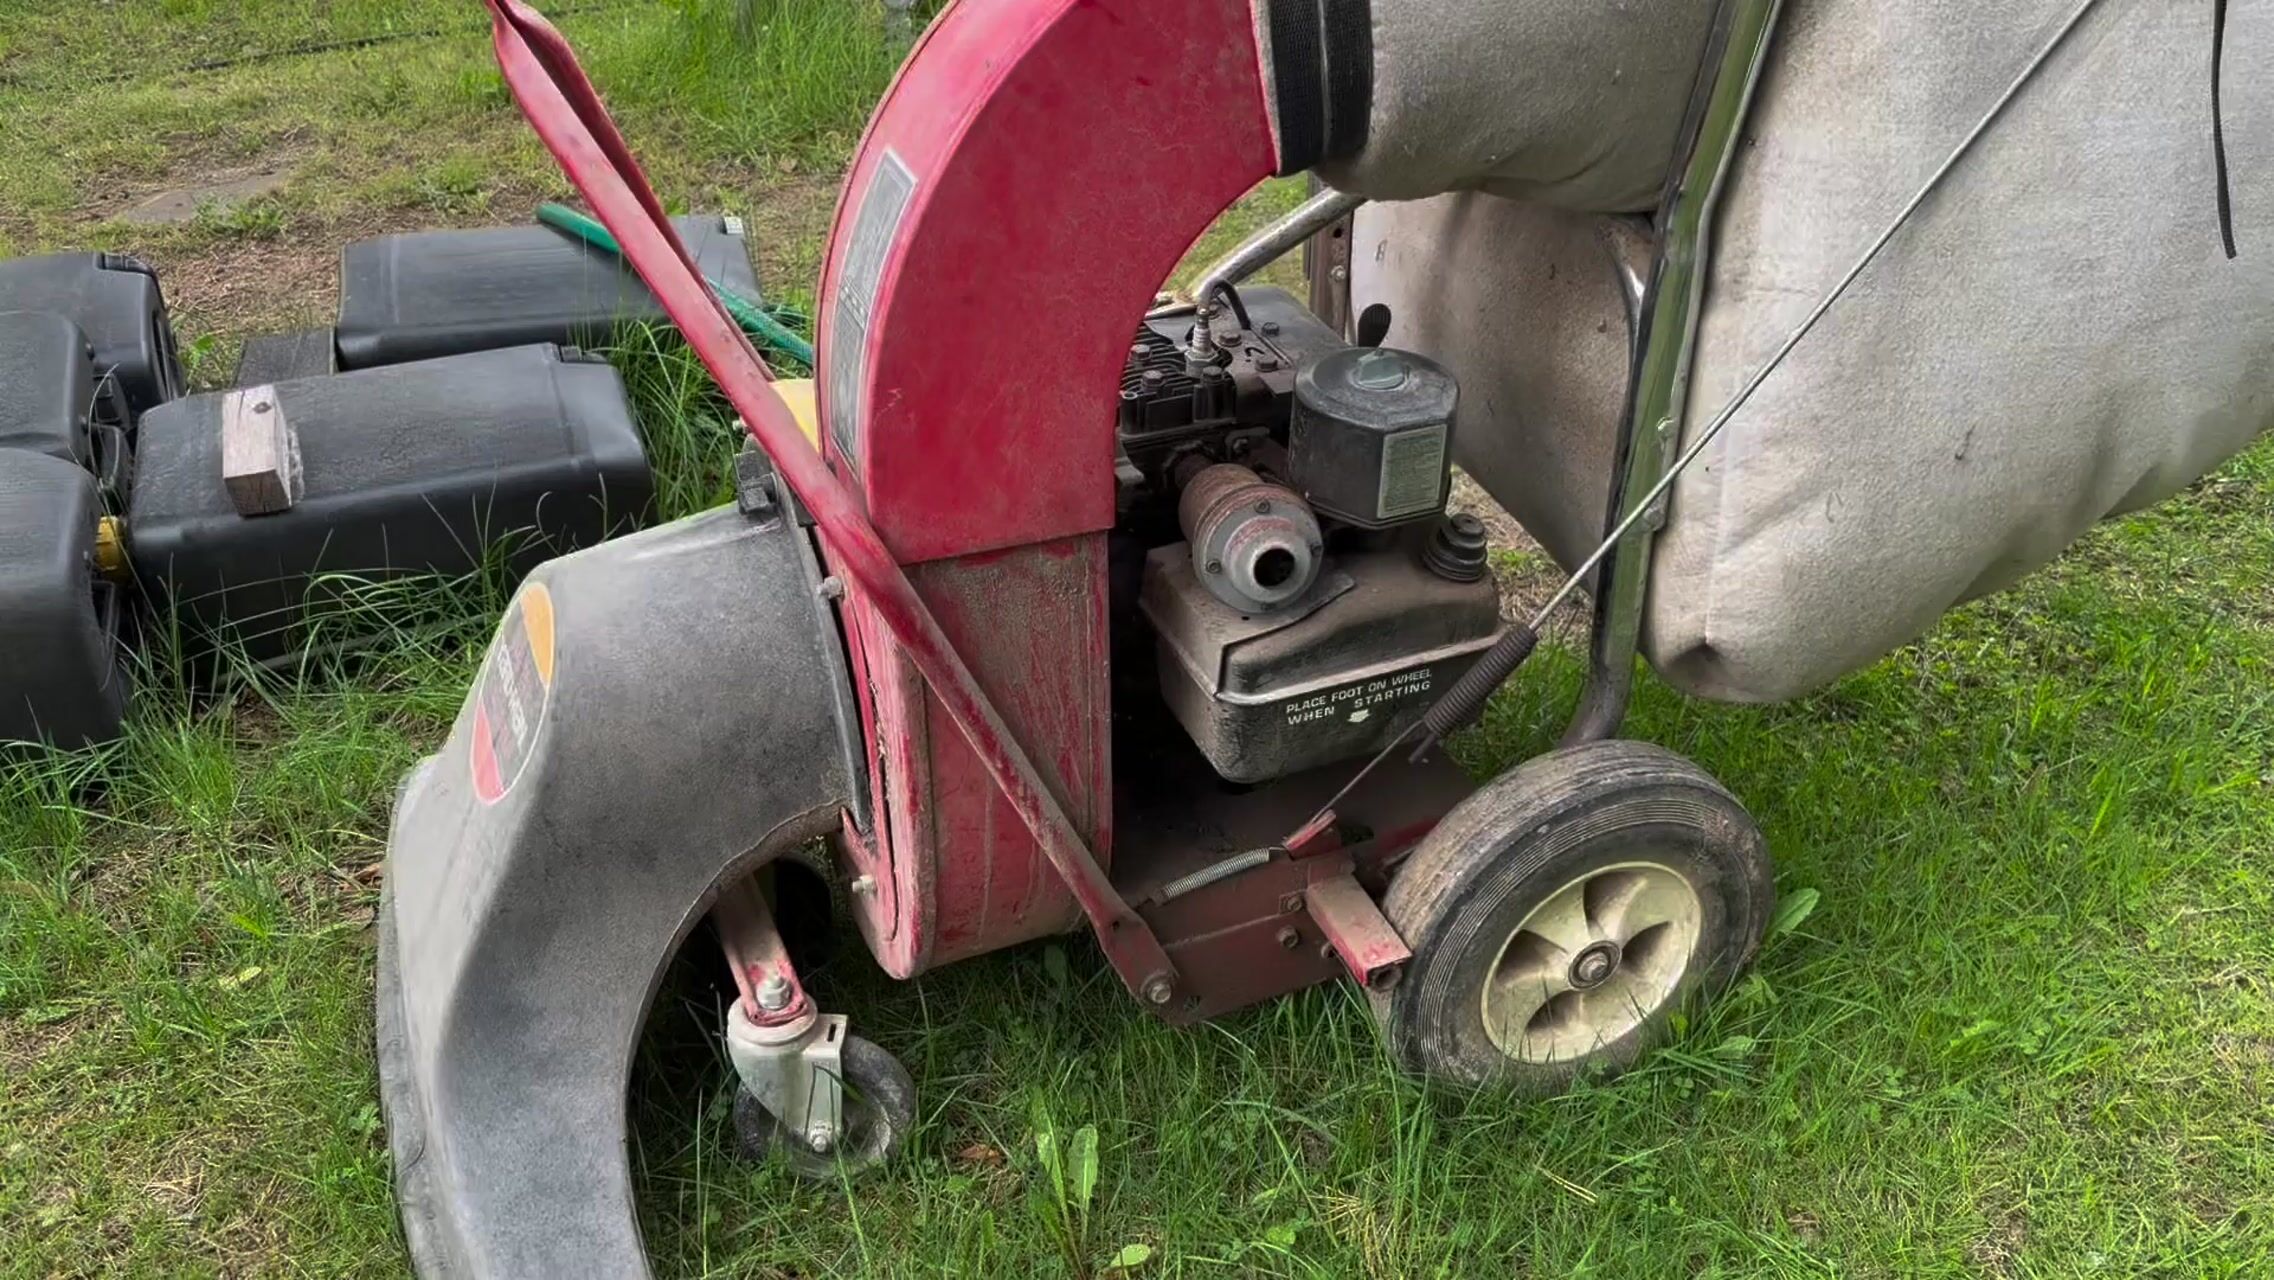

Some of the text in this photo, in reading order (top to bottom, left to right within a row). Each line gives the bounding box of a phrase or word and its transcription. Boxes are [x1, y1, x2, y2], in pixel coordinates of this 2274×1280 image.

[1285, 668, 1432, 714] PLACE FOOT ON WHEEL
[1287, 680, 1431, 725] WHEN STARTING
